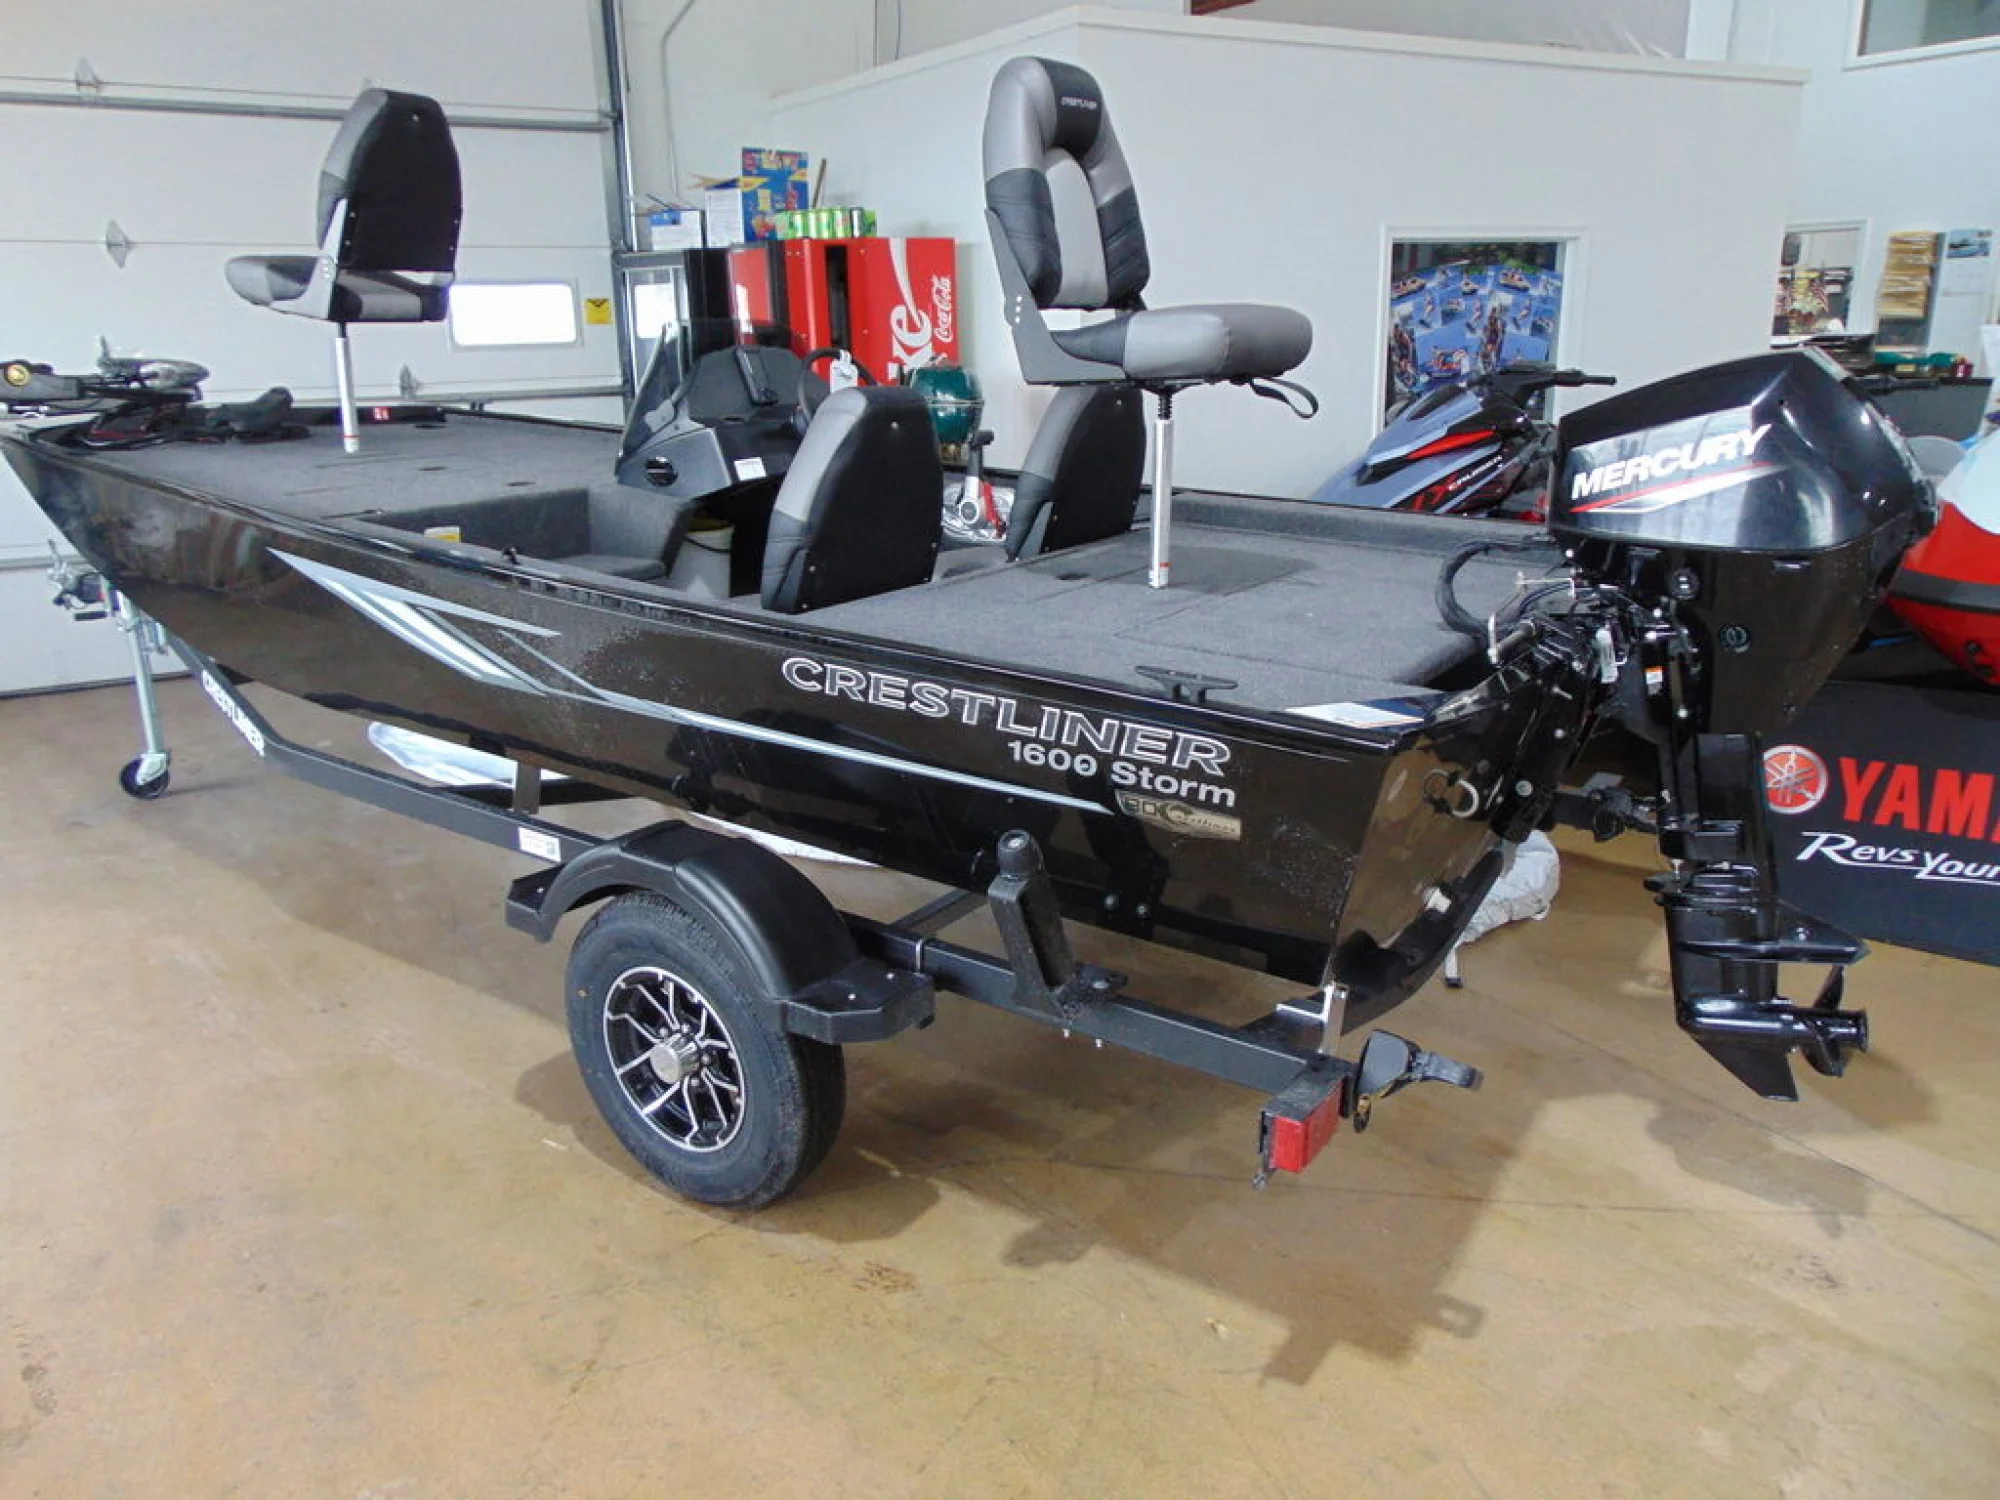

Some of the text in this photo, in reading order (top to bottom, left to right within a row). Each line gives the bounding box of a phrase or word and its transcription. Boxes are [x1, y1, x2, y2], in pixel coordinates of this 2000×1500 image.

[1572, 424, 1772, 500] MERCURY
[782, 657, 1231, 777] CRESTLINER
[1008, 740, 1098, 777] 1600
[1111, 761, 1236, 807] Storm
[1839, 757, 2000, 843] YAM
[1796, 831, 1920, 869] Revs
